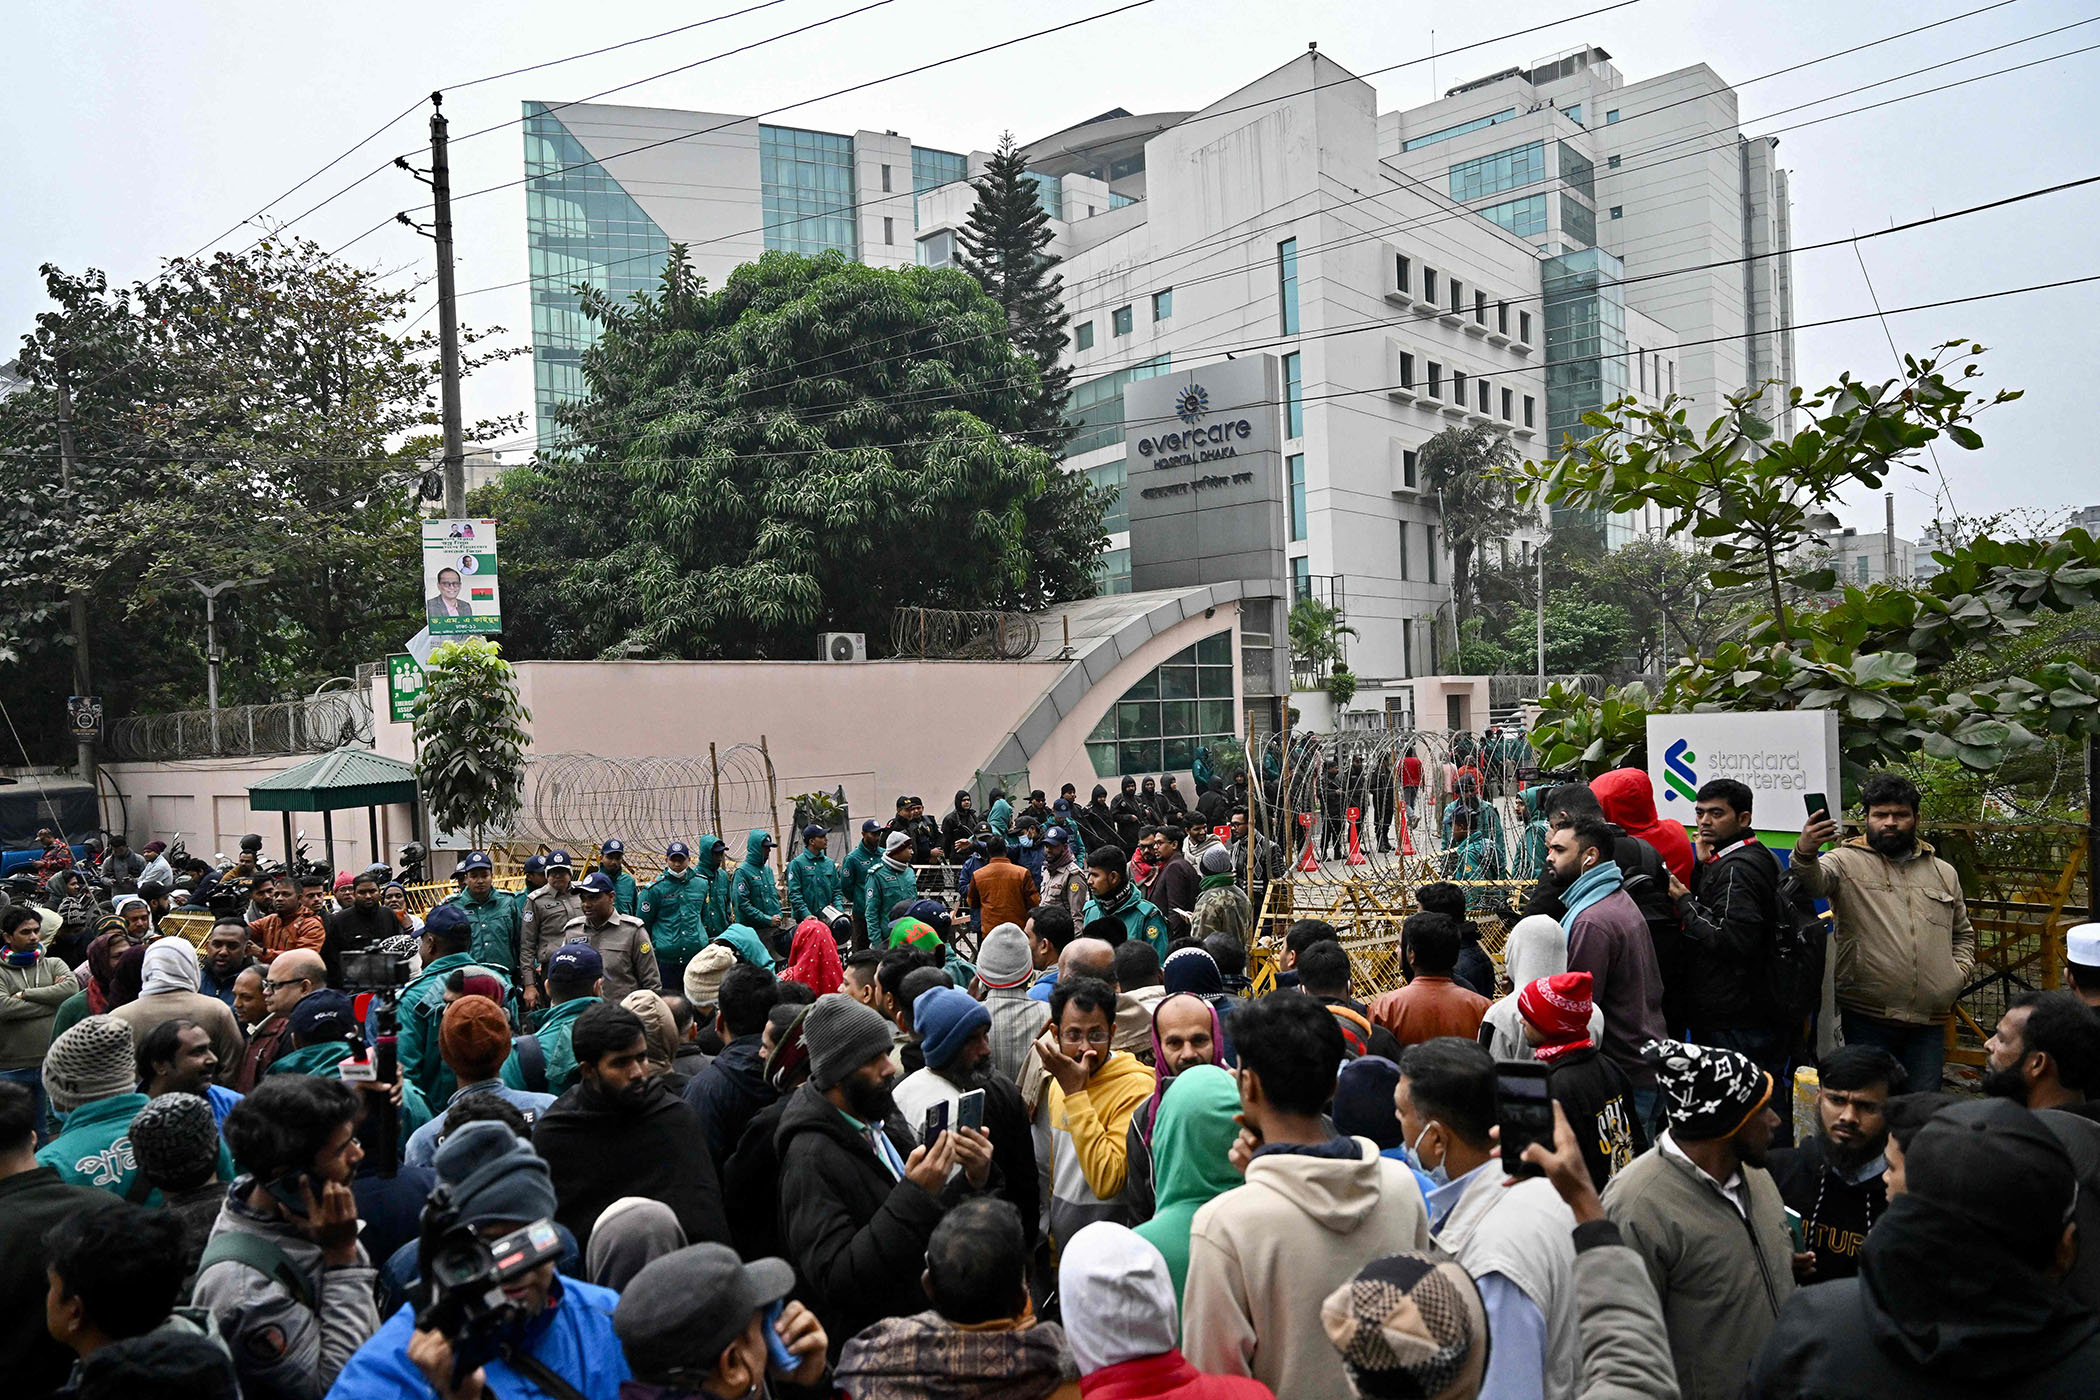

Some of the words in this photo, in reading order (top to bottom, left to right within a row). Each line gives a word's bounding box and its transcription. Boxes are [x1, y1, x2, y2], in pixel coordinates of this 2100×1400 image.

[1138, 419, 1252, 457] evercare
[1153, 452, 1196, 470] HOSPITAL
[1200, 446, 1238, 462] DHAKA
[1708, 750, 1800, 770] standard
[556, 954, 577, 963] POLICE
